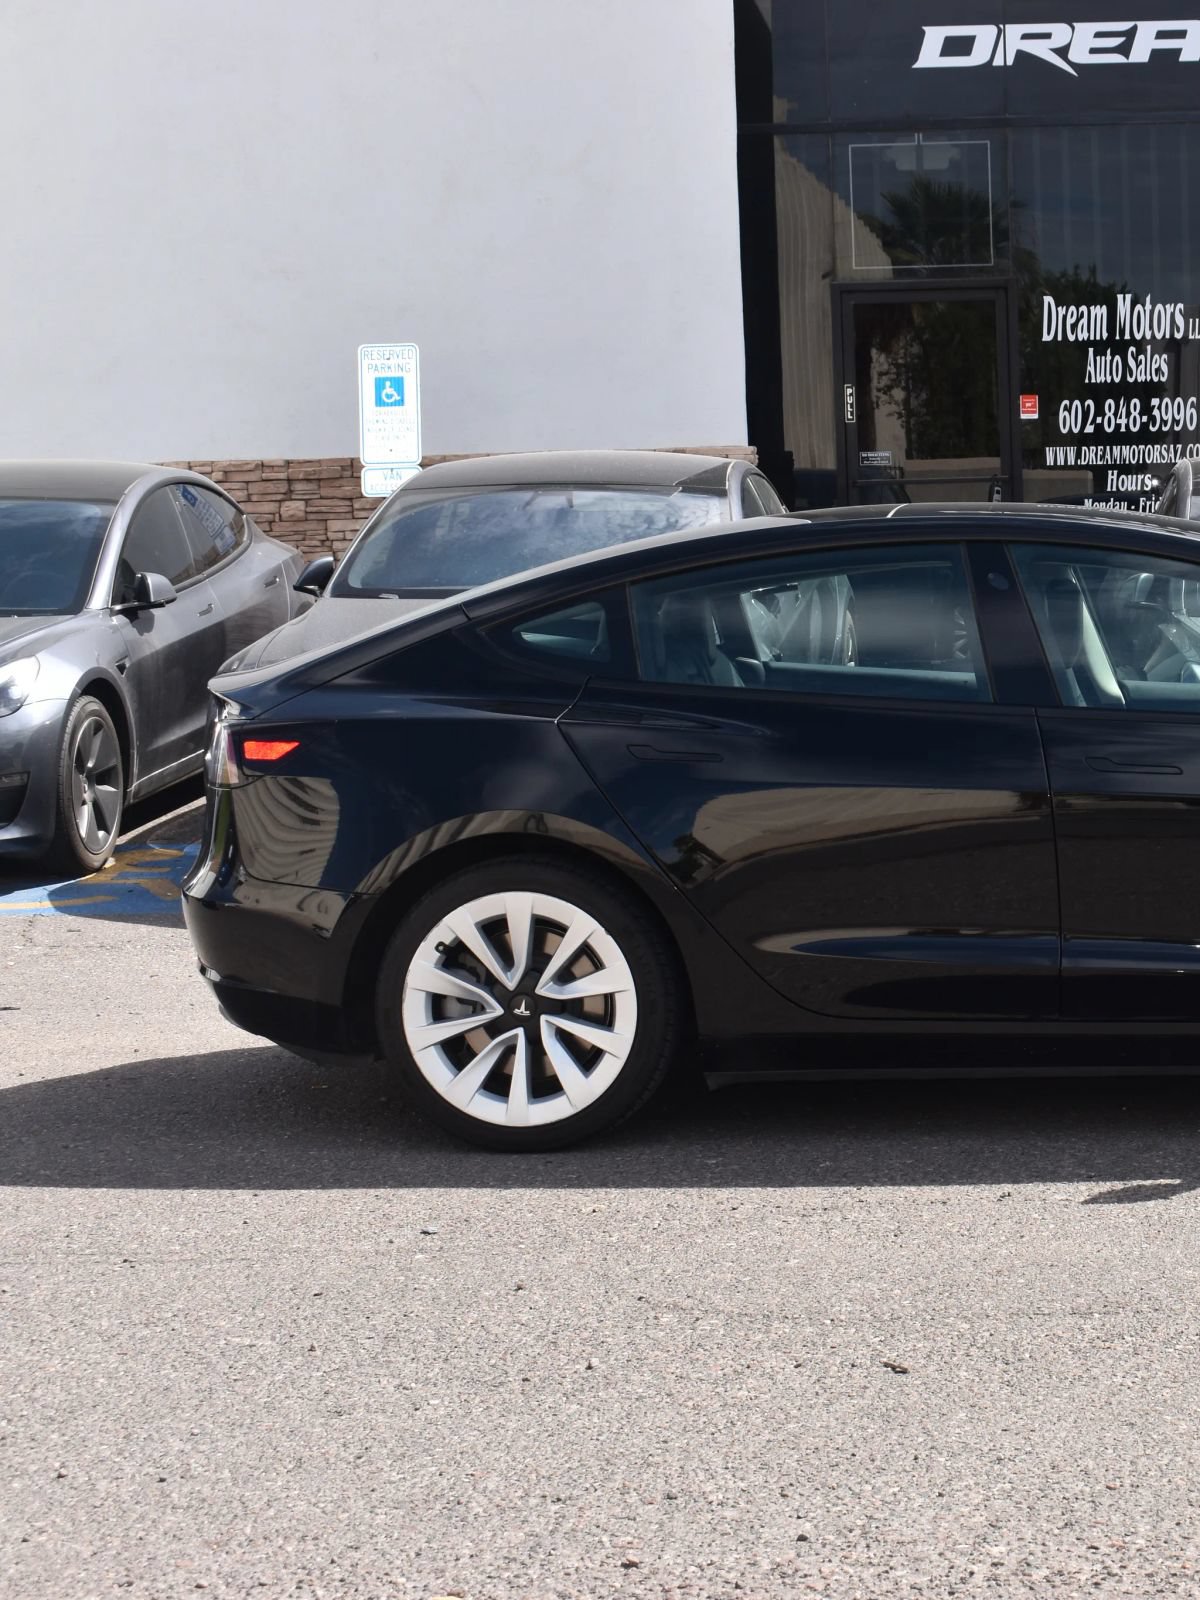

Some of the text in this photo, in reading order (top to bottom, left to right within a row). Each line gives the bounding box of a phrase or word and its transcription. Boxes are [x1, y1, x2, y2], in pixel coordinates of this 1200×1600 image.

[1042, 295, 1108, 342] Dream
[1115, 293, 1185, 340] Motors
[363, 348, 414, 361] RESERVED
[367, 362, 411, 374] PARKING
[1085, 345, 1169, 383] Auto Sales
[1058, 396, 1198, 434] 602-848-3996
[383, 470, 402, 481] VAN
[1106, 470, 1152, 492] Hours
[1084, 497, 1128, 512] Monday
